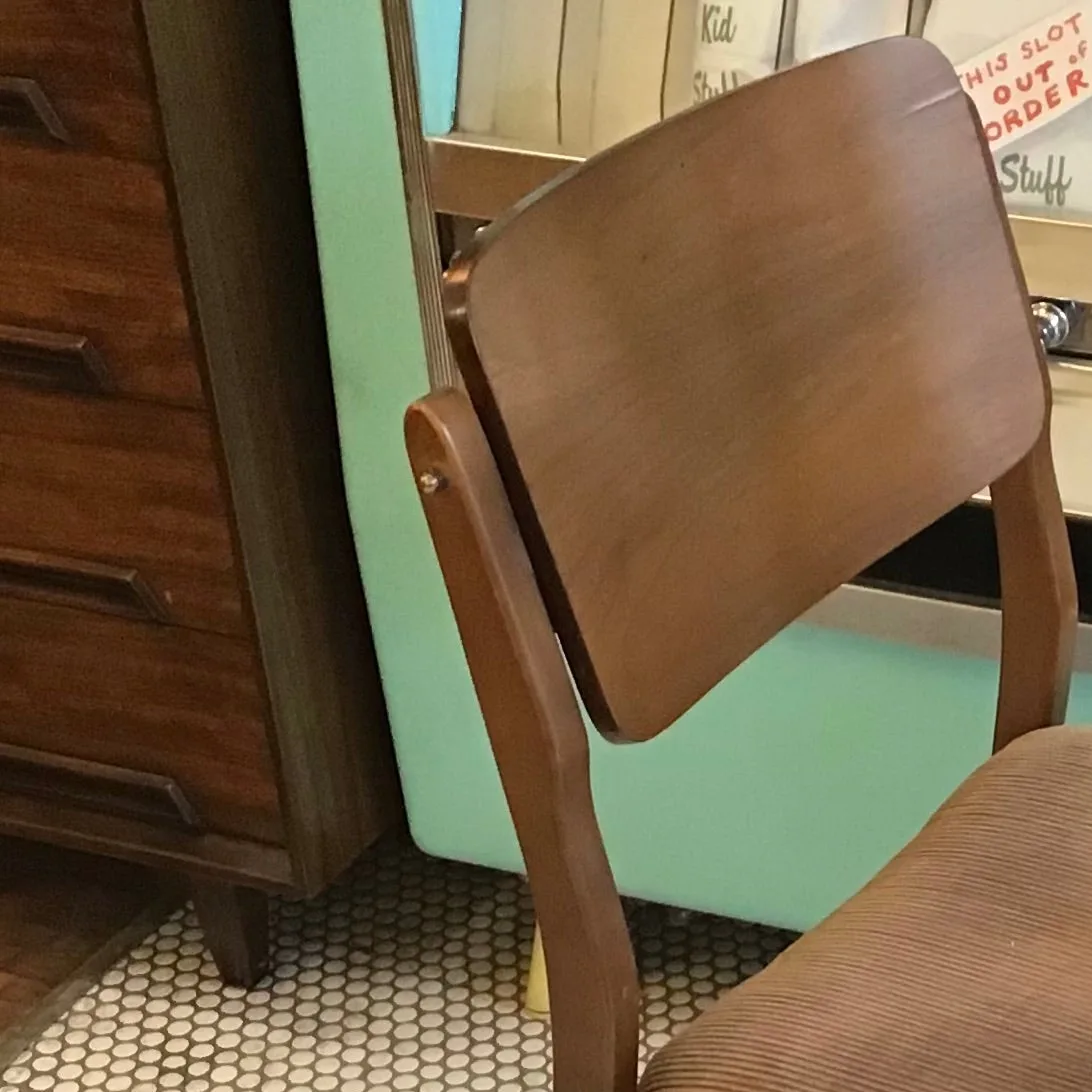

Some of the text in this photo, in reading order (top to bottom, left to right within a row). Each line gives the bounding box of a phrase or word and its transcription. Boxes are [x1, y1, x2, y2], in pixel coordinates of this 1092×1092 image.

[701, 3, 738, 44] Kid
[1020, 12, 1083, 60] SLOT
[983, 68, 1090, 142] ORDER
[992, 60, 1054, 105] OUT
[1000, 152, 1073, 206] Stuff
